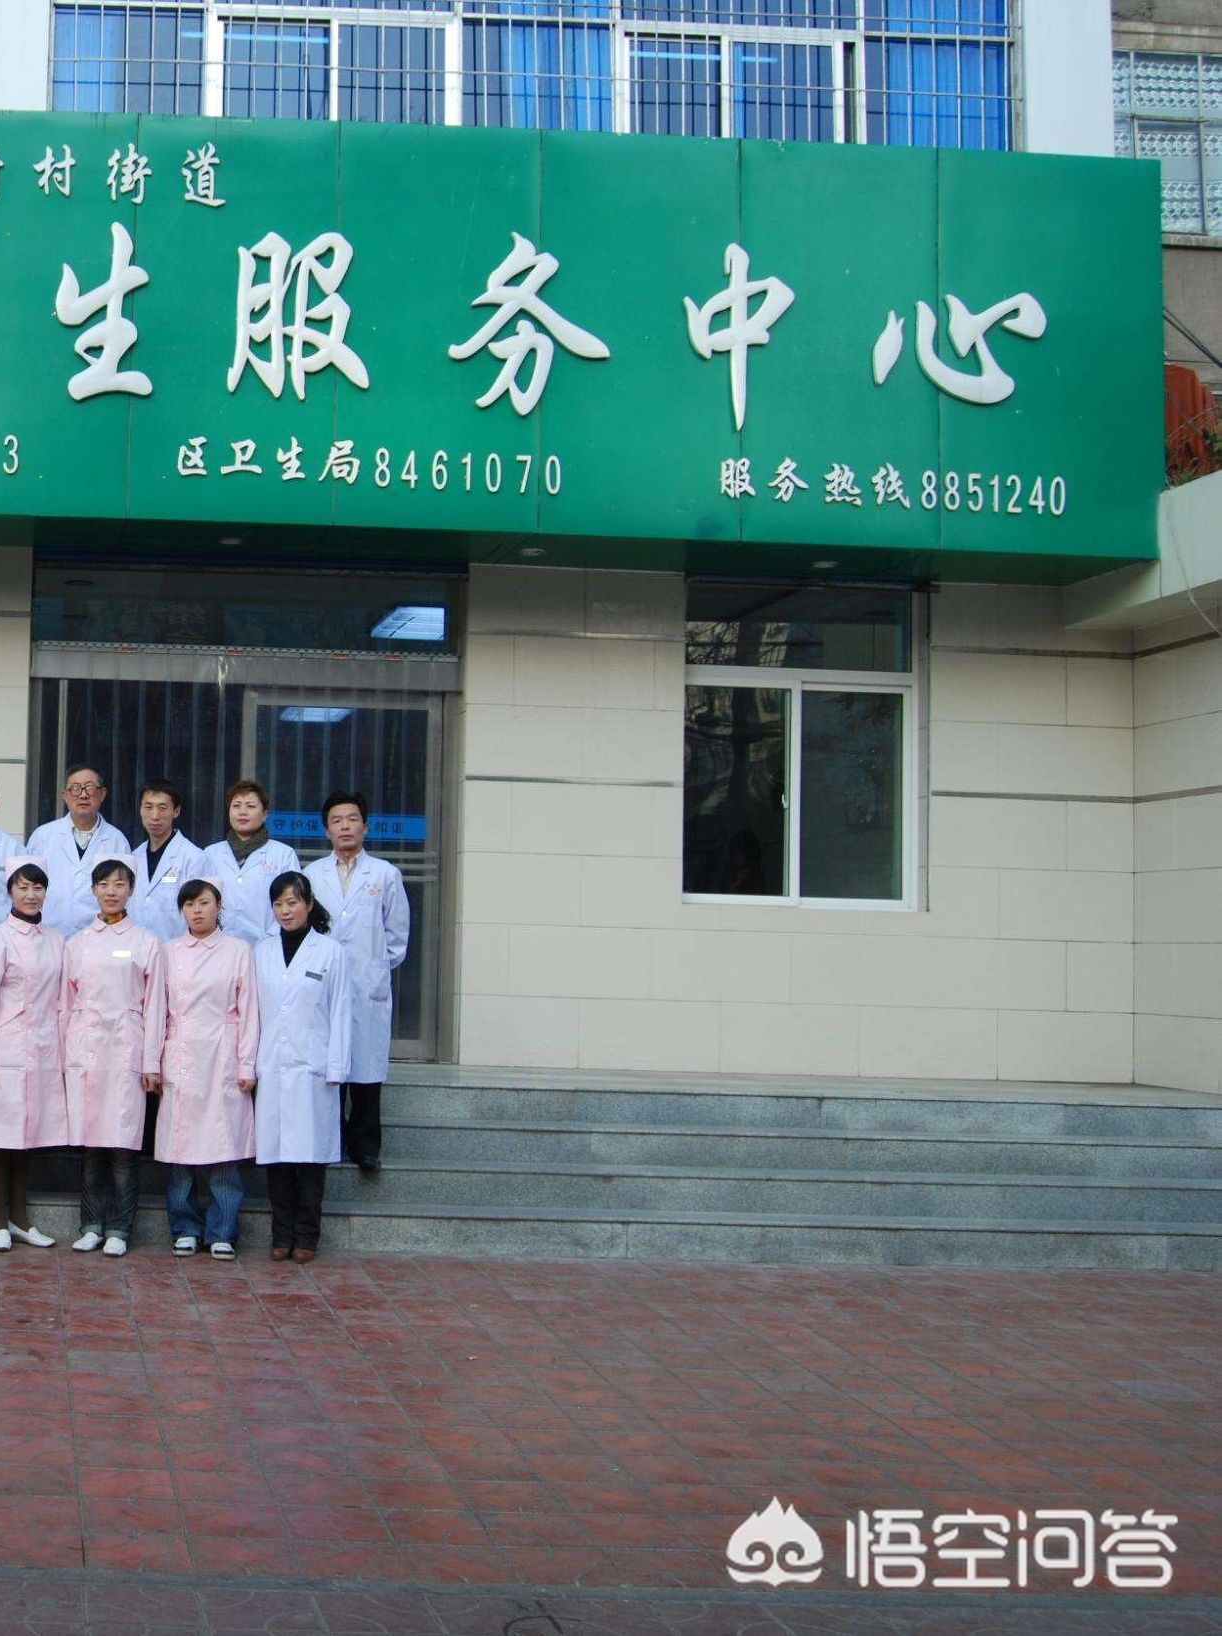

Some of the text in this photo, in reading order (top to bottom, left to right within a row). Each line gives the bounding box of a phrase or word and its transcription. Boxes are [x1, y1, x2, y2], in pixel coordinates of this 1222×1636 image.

[177, 435, 563, 496] 区卫生局8461070
[719, 456, 1068, 516] 服务热线8851240
